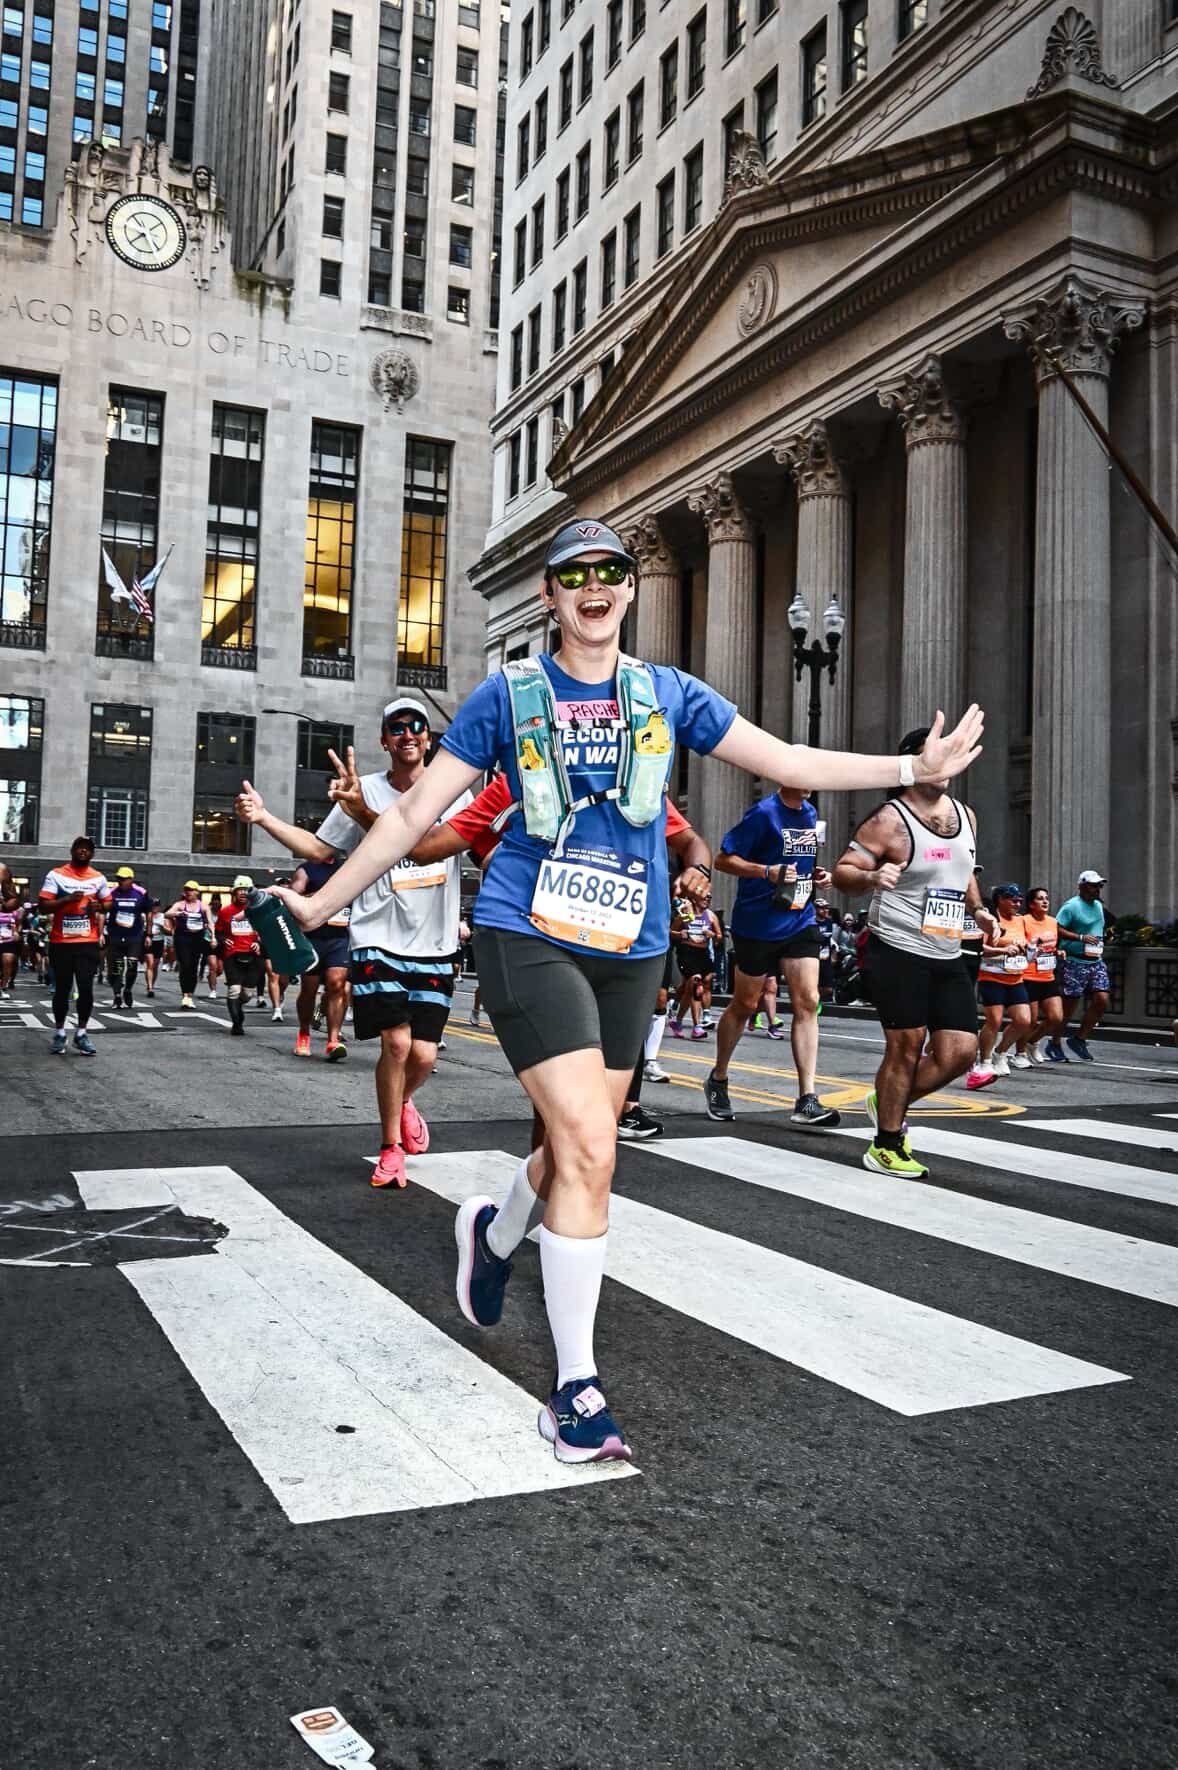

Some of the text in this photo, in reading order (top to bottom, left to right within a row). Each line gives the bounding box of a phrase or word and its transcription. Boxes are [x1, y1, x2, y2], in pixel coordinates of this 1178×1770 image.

[0, 293, 350, 377] AGO BOARD OF TRADE
[561, 727, 618, 744] ECOV
[540, 865, 644, 915] M68826
[276, 914, 297, 950] NATHAN
